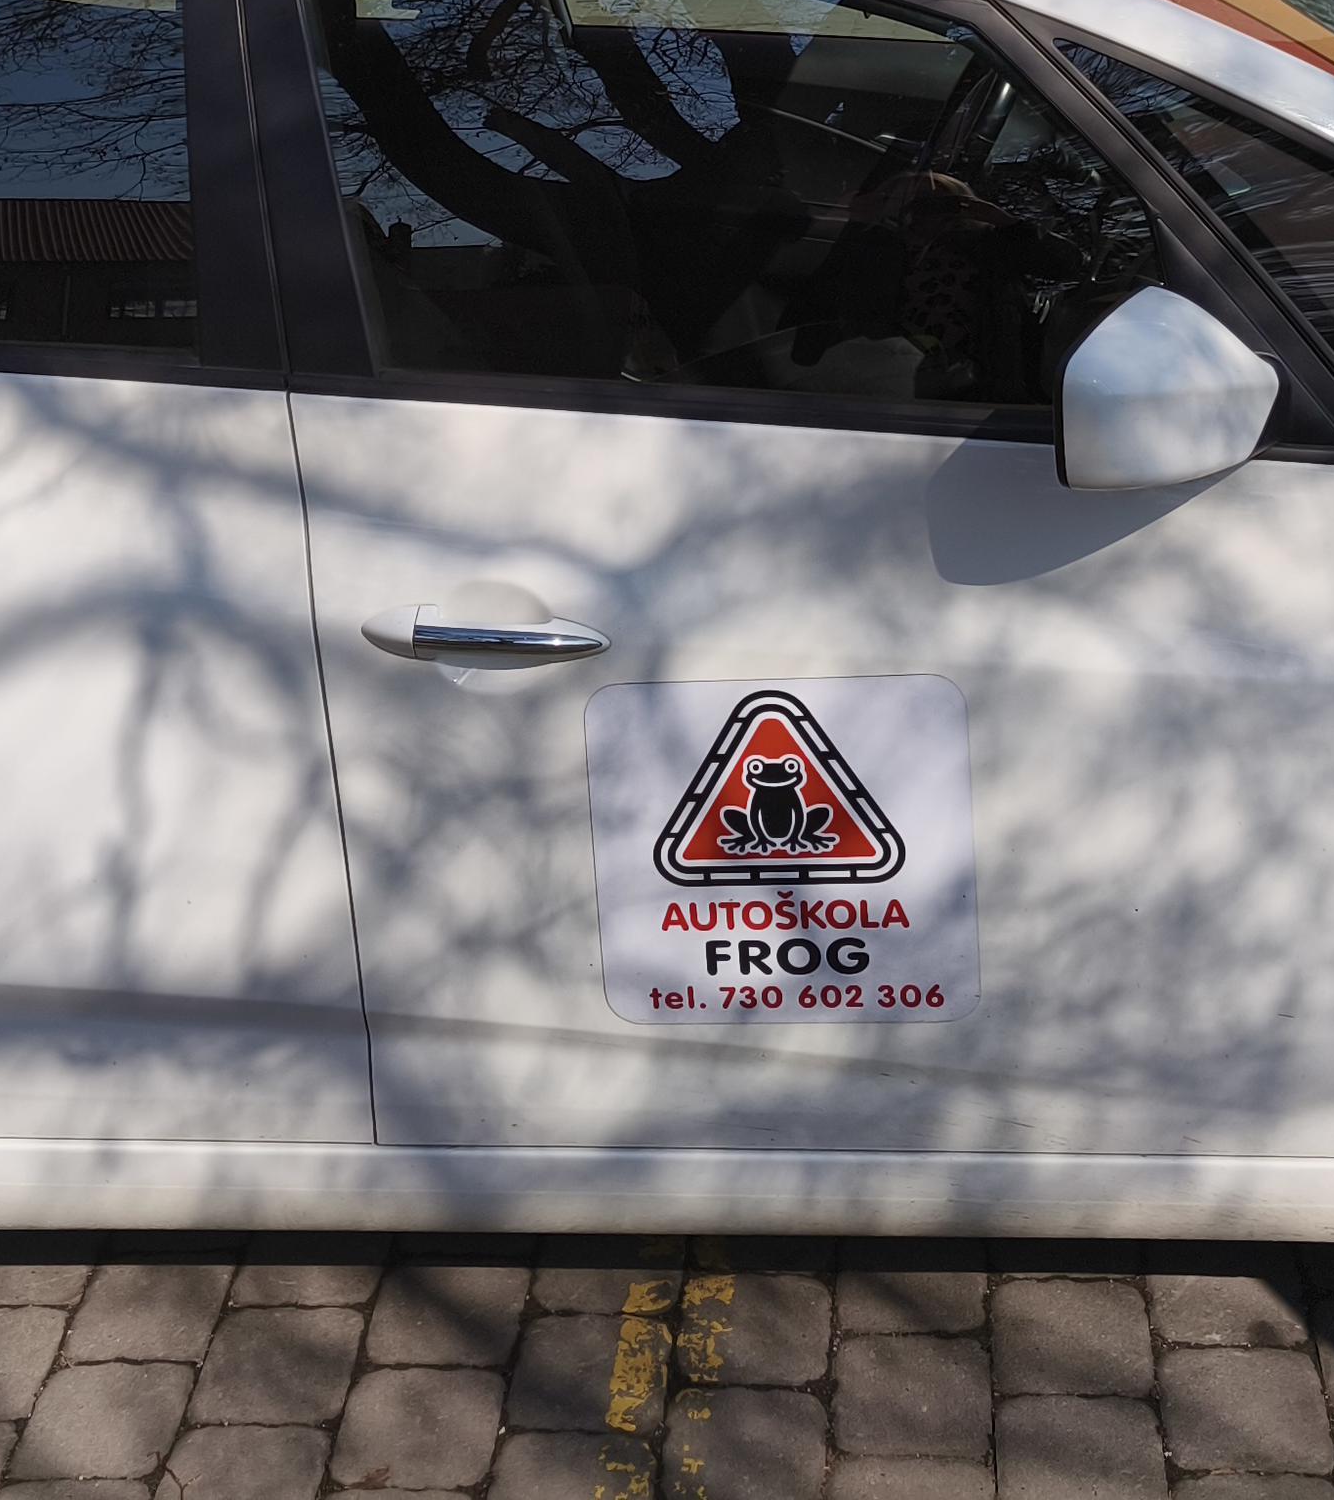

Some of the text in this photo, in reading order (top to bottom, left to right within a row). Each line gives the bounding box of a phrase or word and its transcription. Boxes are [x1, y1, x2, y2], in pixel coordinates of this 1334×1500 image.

[661, 890, 910, 932] AUTOŠKOLA
[705, 936, 870, 976] FROG
[649, 983, 946, 1010] tel. 730 602 306
